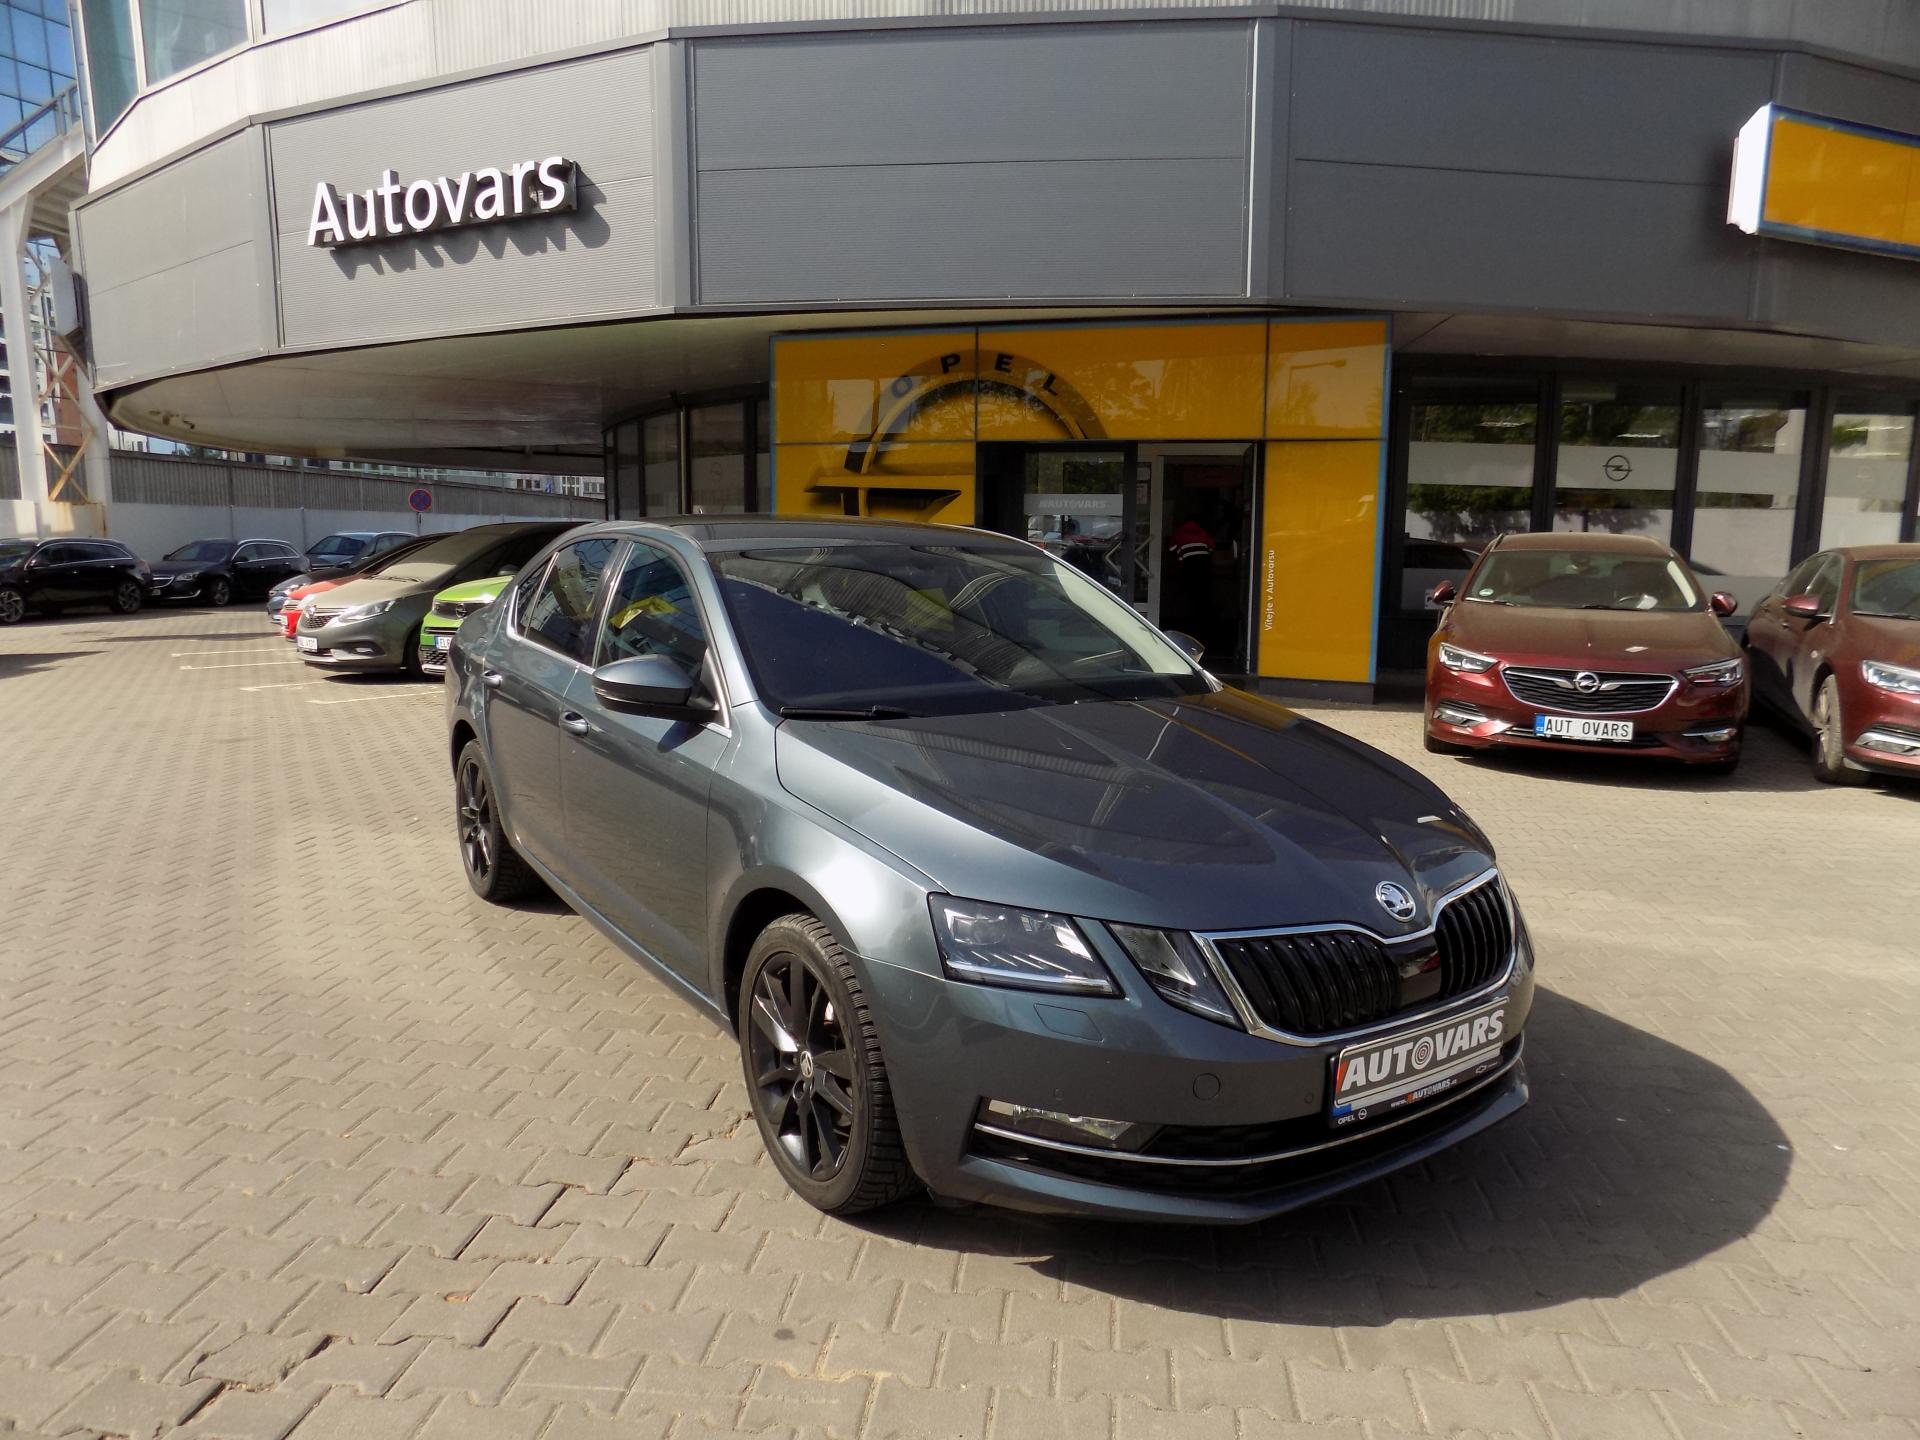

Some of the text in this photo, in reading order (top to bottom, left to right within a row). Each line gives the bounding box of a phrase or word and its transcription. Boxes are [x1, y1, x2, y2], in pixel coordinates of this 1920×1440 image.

[307, 156, 566, 247] Autovars
[891, 352, 1059, 398] OPEL
[1266, 550, 1275, 594] Autovarsu
[1545, 718, 1630, 738] AUT OVARS
[1340, 1009, 1504, 1092] AUTOVARS
[1338, 1115, 1355, 1125] OPEL
